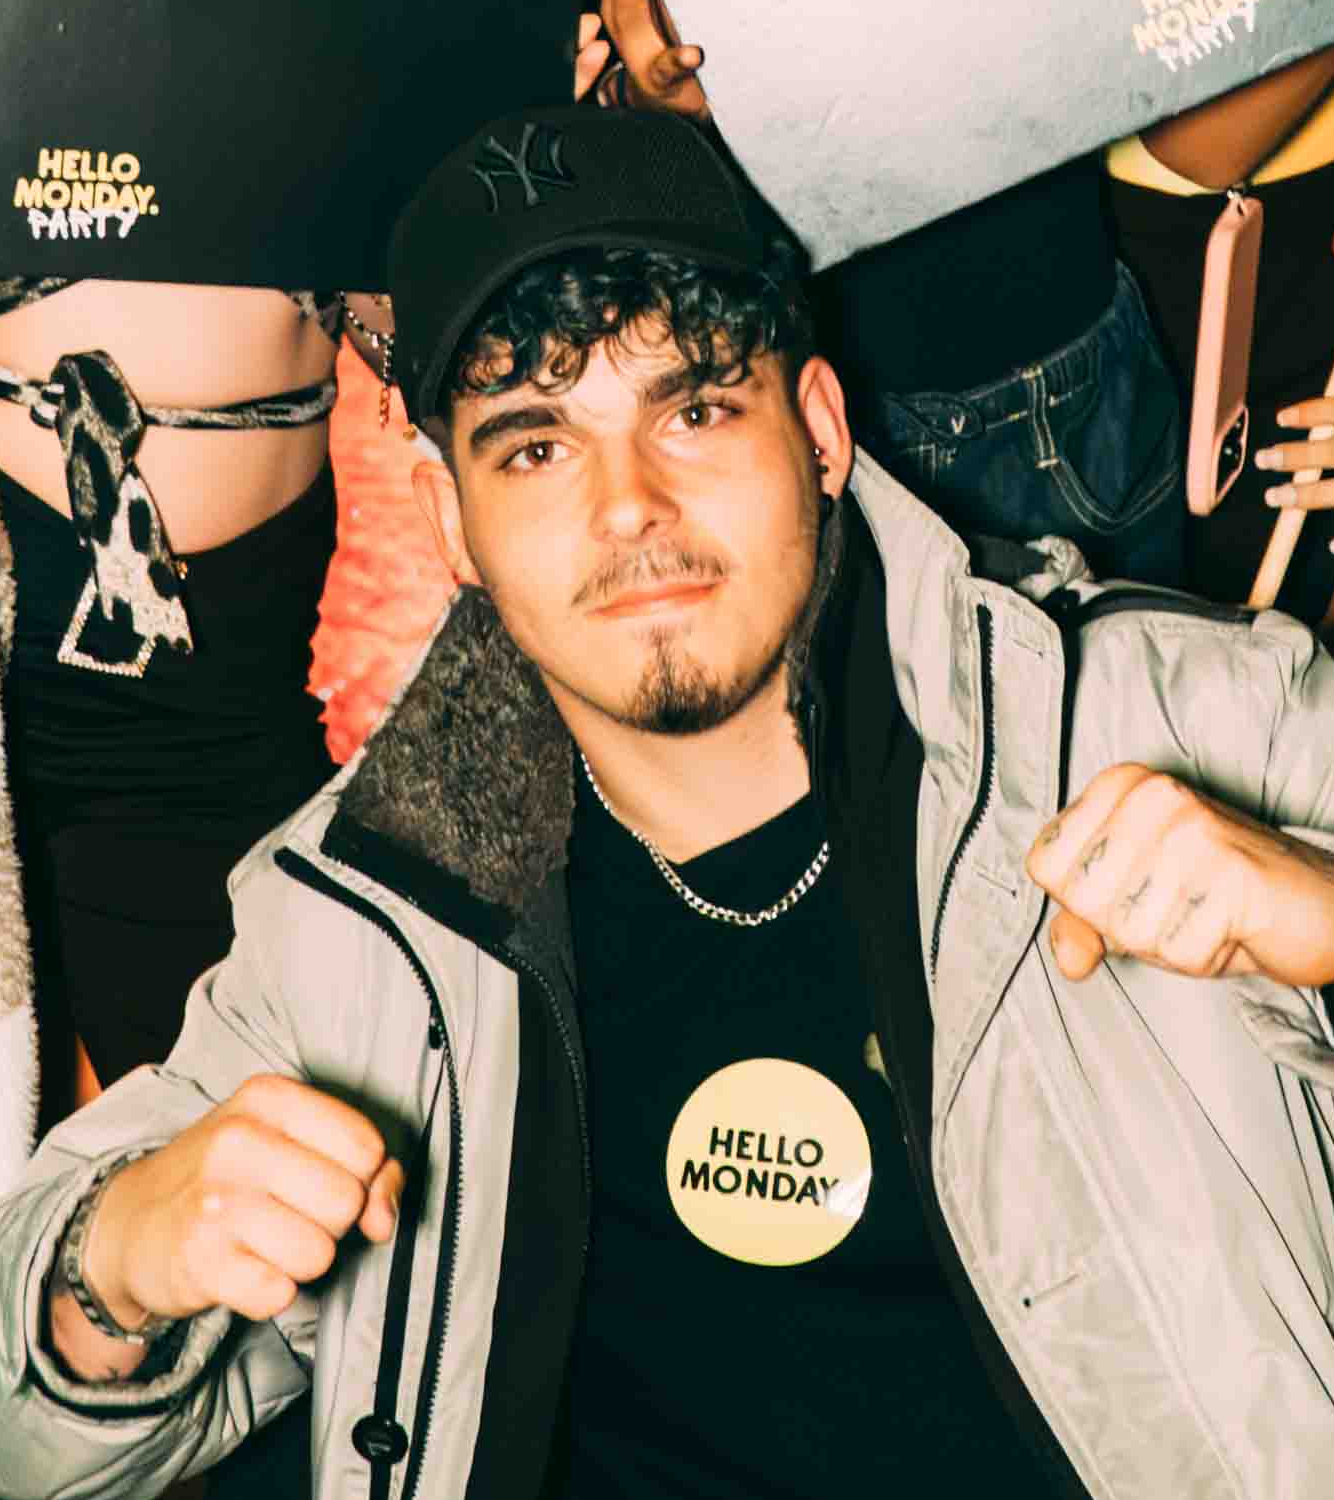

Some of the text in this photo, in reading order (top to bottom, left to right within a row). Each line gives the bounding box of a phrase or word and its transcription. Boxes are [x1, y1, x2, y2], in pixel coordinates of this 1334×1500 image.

[37, 148, 141, 184] HELLO
[12, 177, 159, 217] MONDAY.
[26, 206, 140, 241] PARTY
[708, 1126, 824, 1168] HELLO
